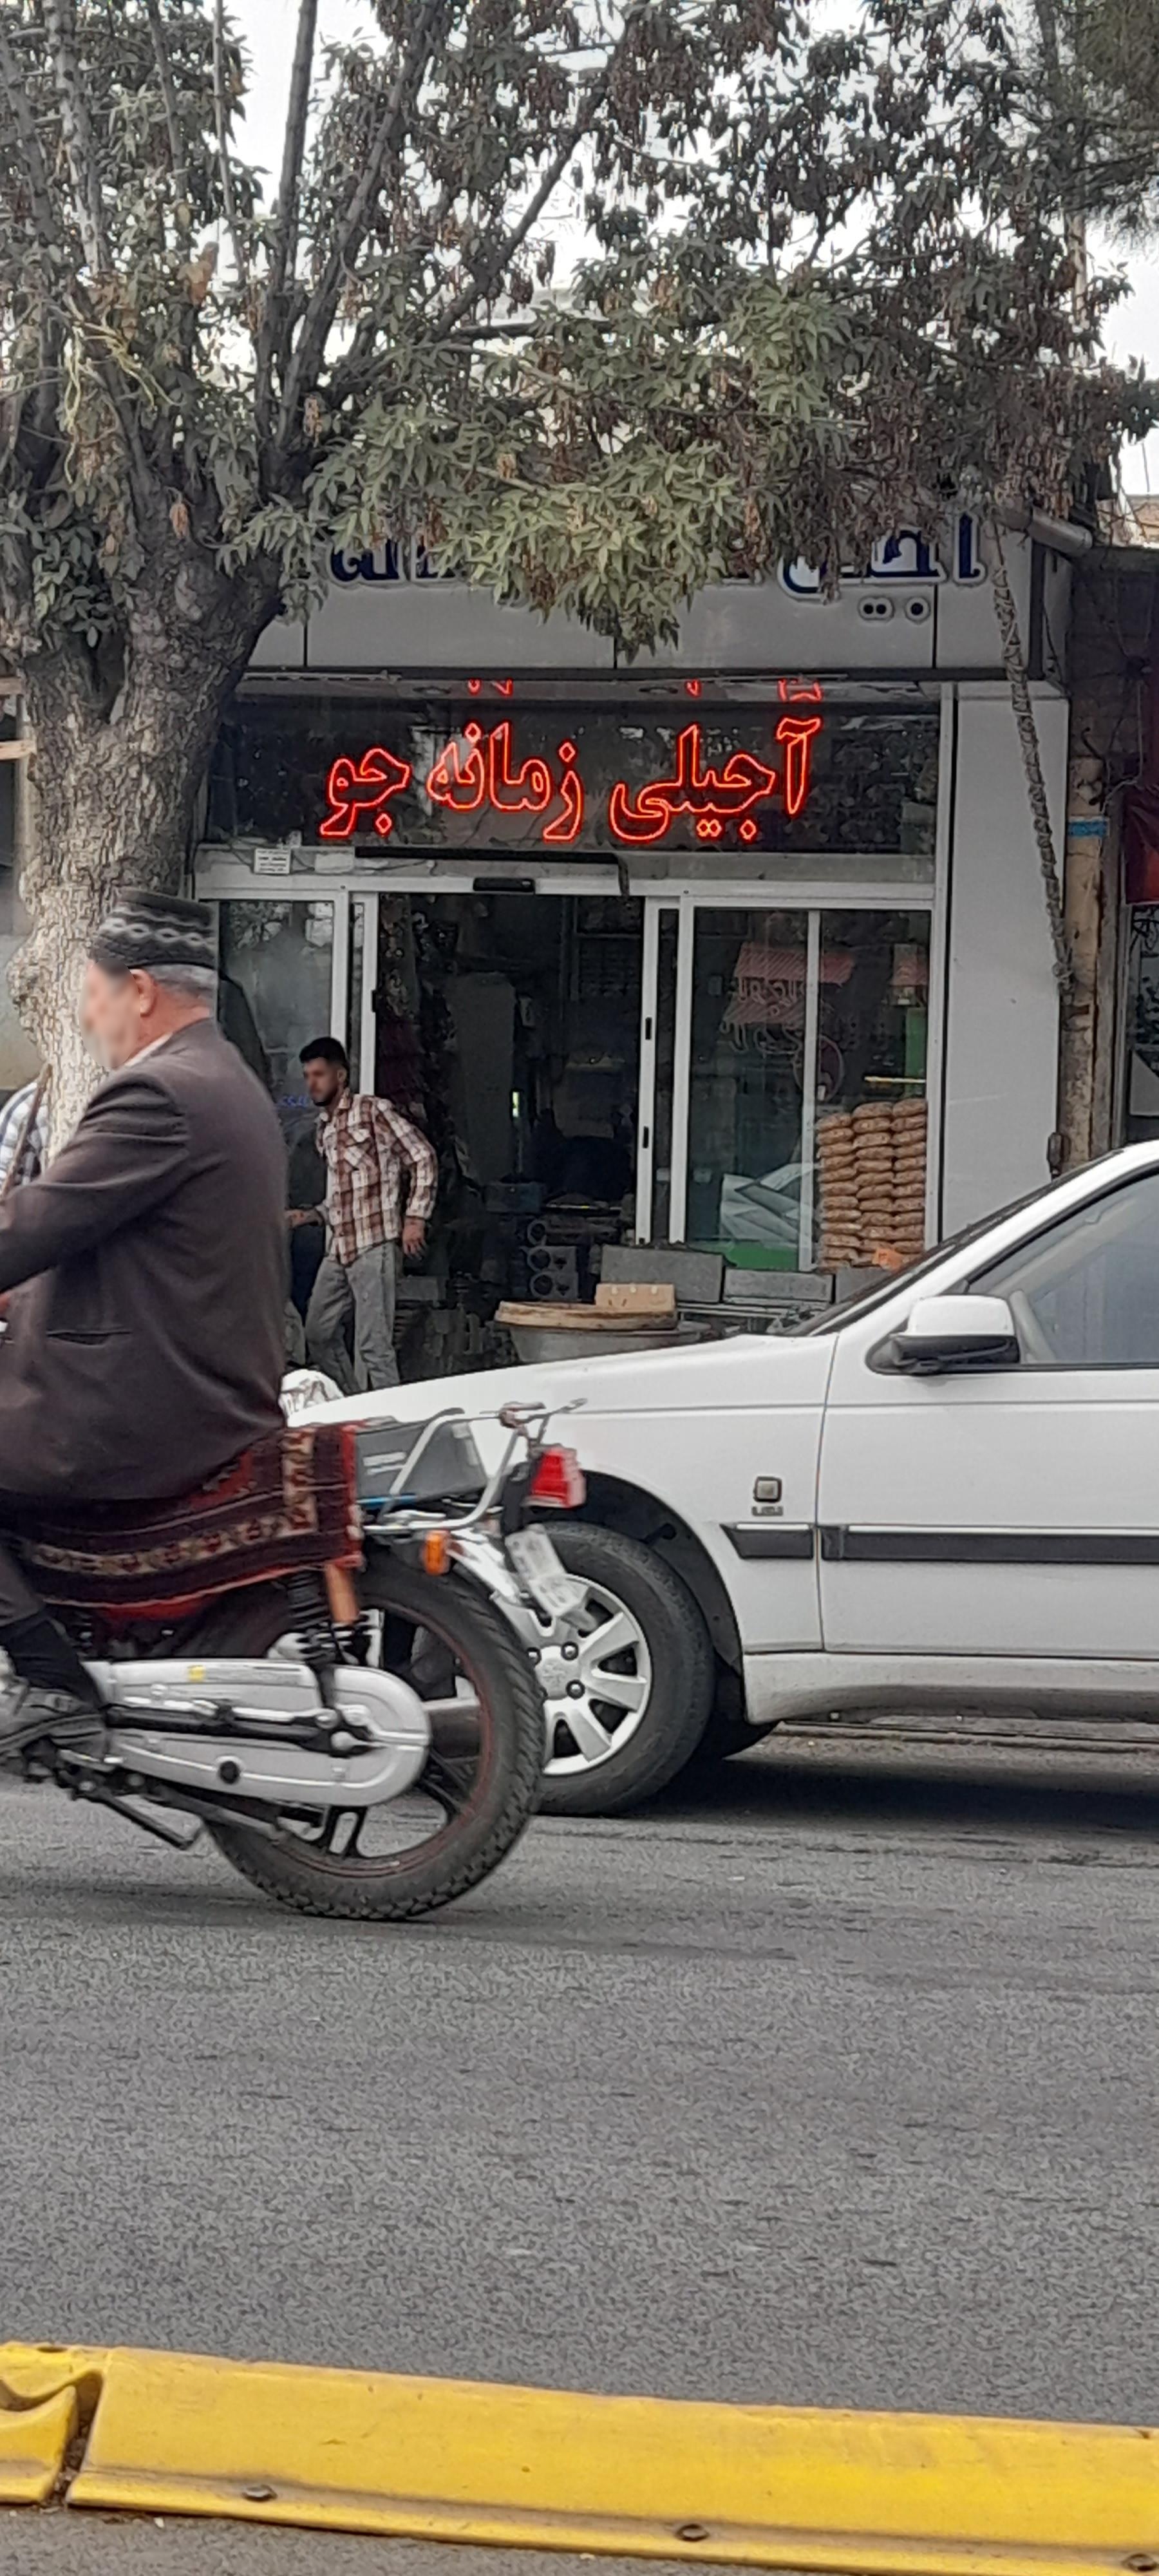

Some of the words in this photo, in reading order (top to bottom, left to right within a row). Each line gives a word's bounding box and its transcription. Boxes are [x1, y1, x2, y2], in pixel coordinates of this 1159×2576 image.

[318, 746, 411, 838] جو
[424, 721, 585, 844] زمانه
[608, 715, 823, 843] آجیلی
